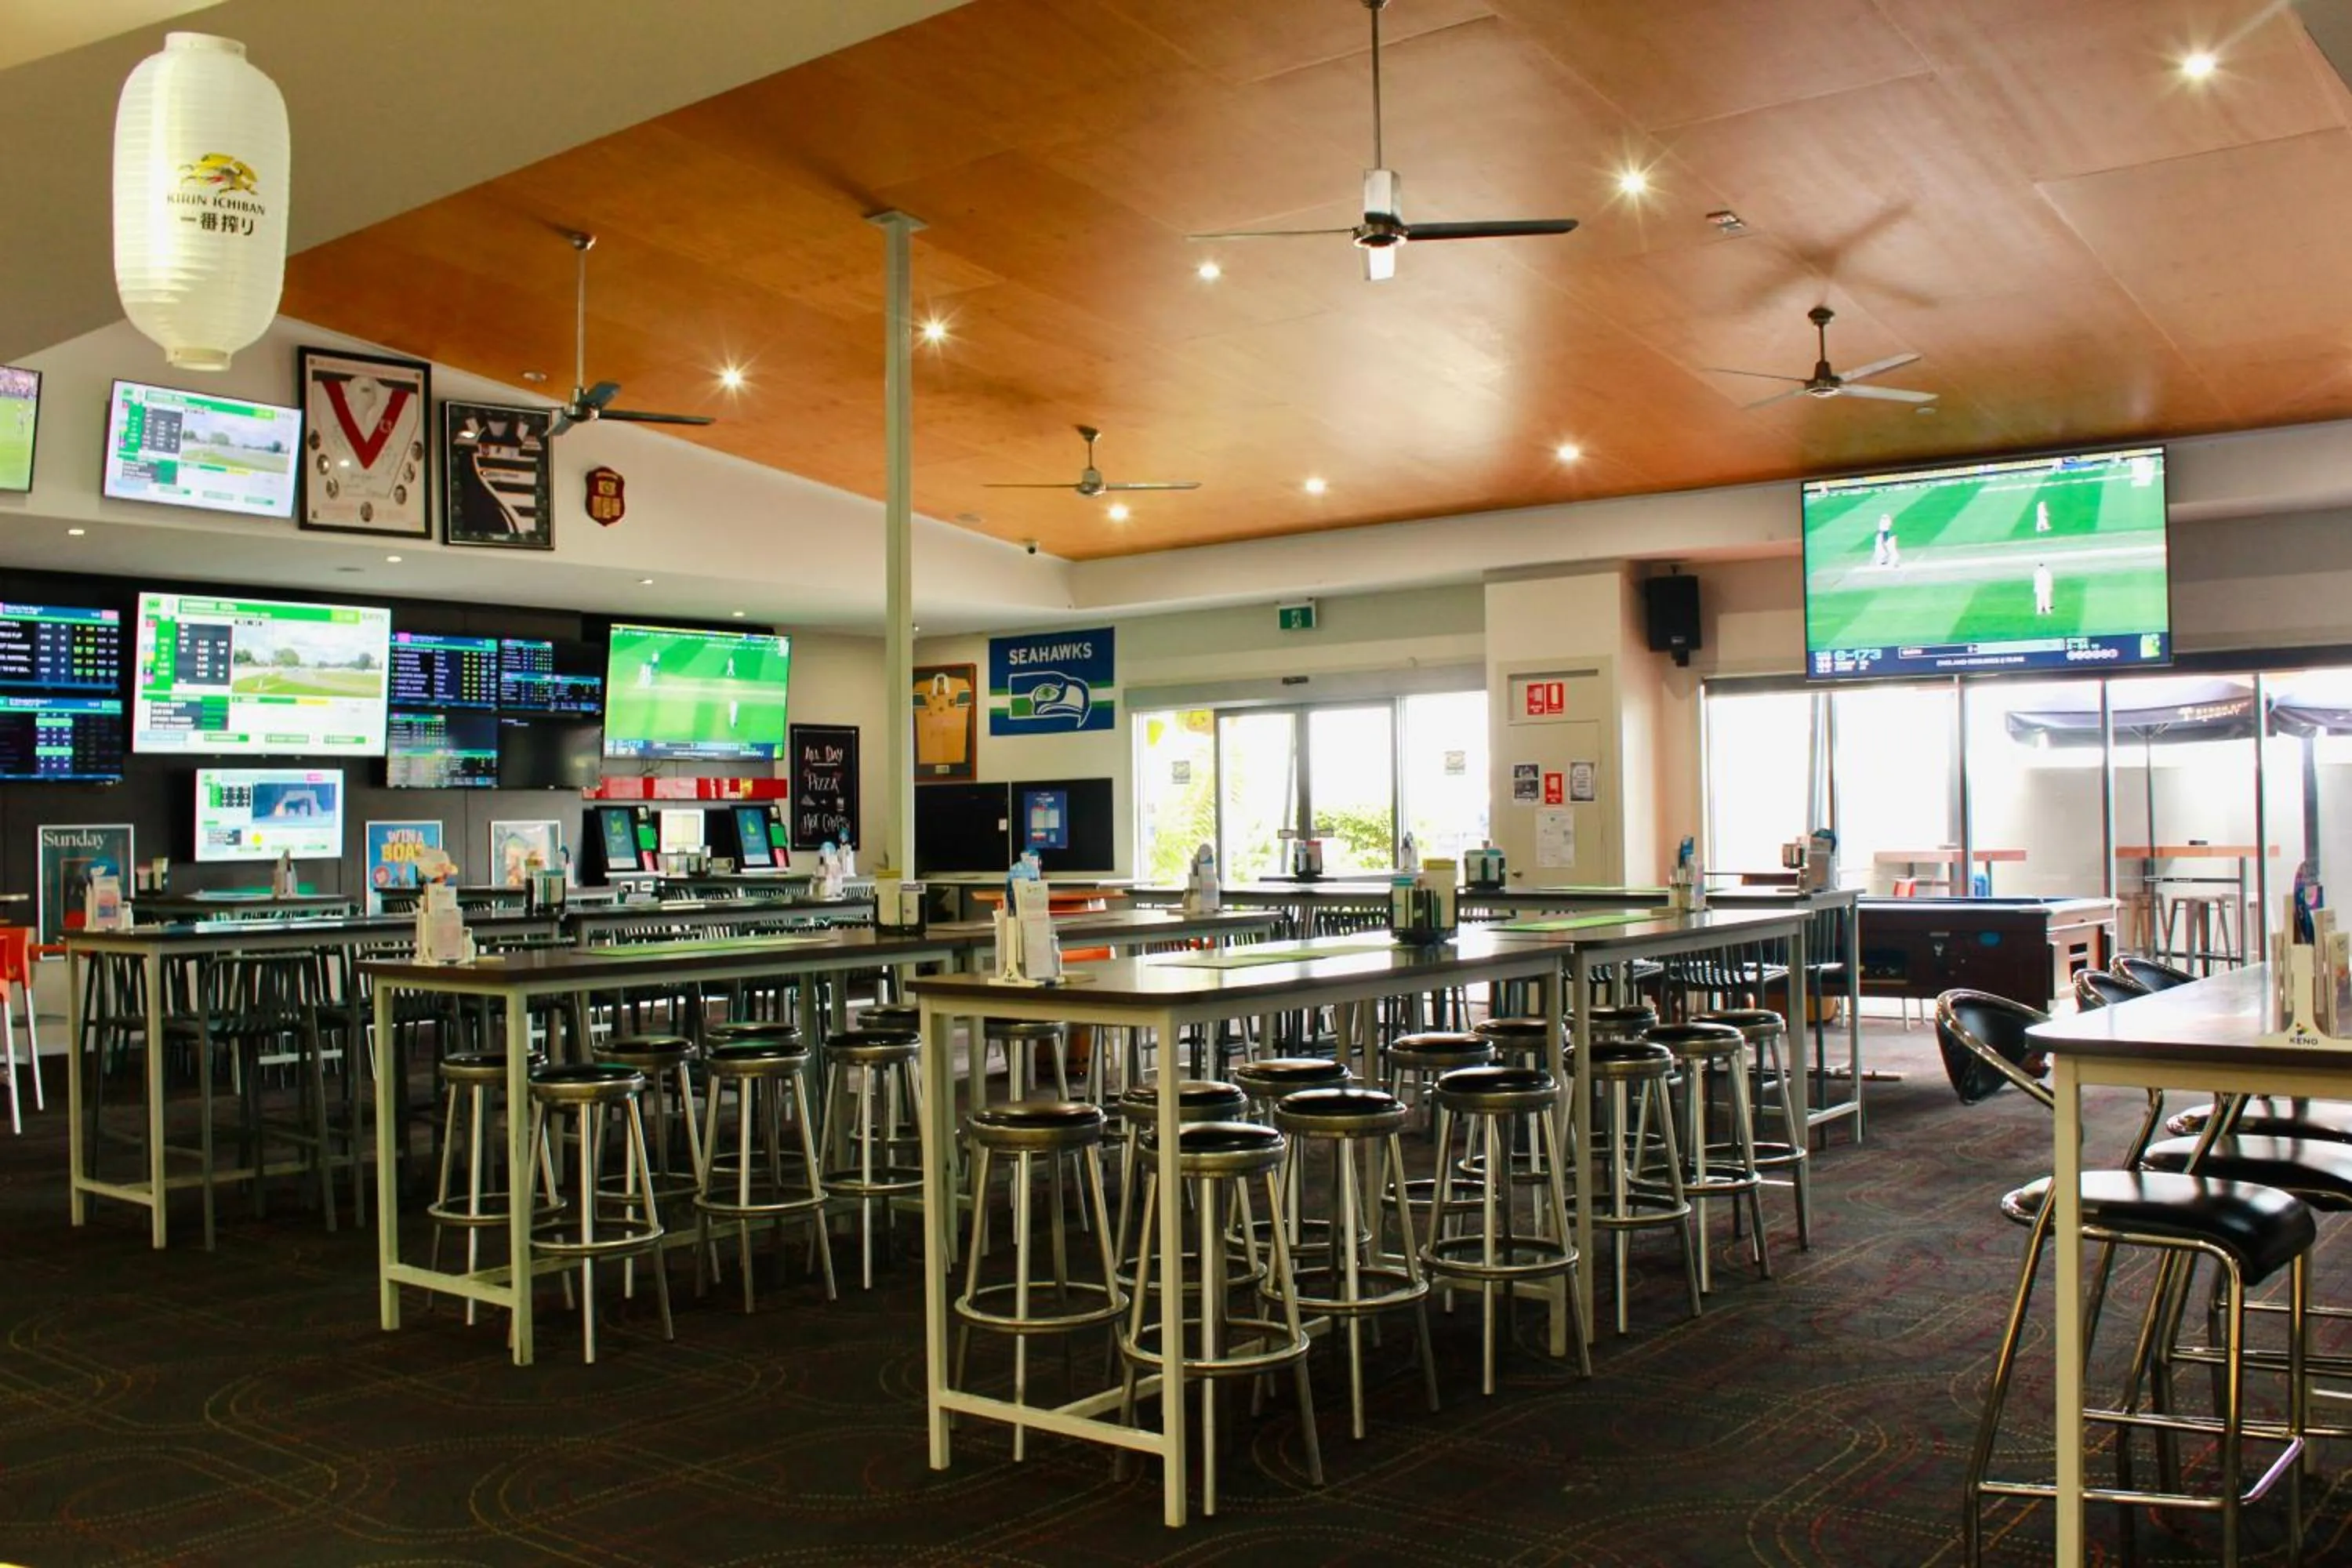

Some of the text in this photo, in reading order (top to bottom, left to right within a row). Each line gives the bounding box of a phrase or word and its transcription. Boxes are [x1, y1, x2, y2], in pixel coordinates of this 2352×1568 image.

[212, 196, 266, 216] ICHIBAN
[180, 211, 254, 235] 一番搾り
[1009, 642, 1092, 665] SEAHAWKS
[43, 829, 107, 850] Sunday
[2289, 1036, 2318, 1045] KENO
